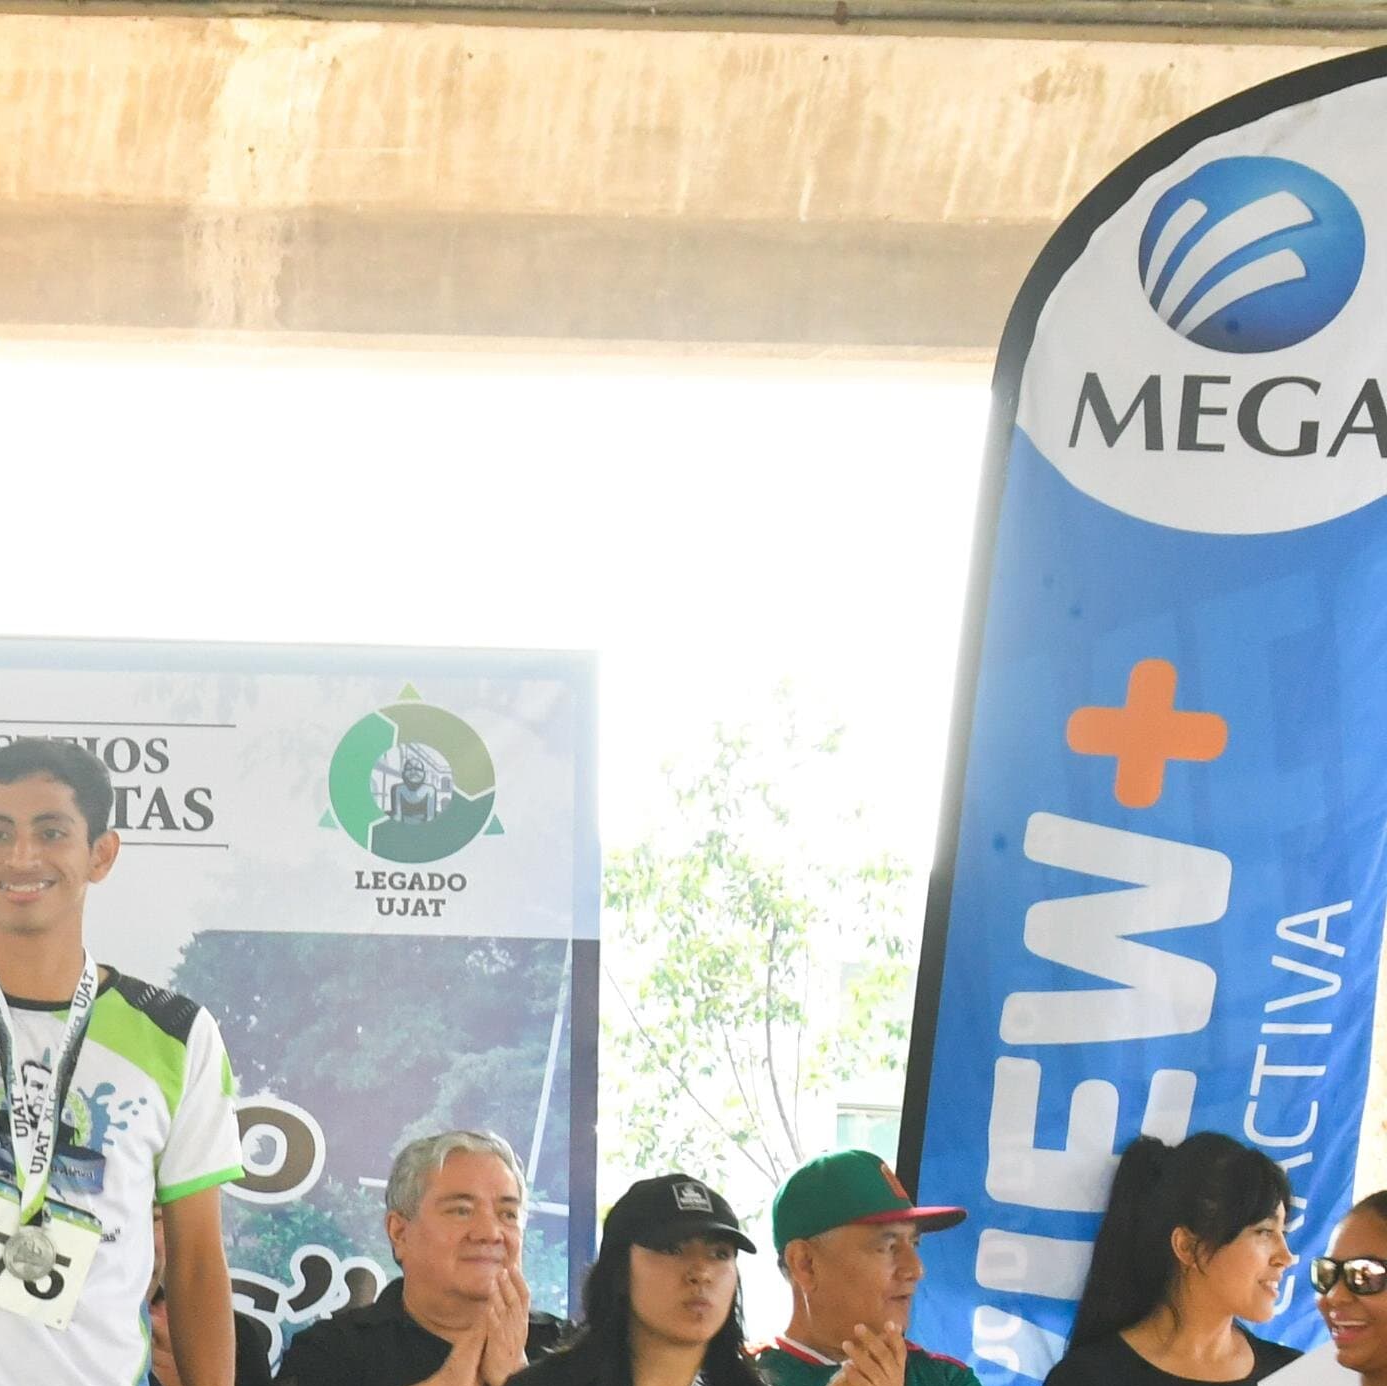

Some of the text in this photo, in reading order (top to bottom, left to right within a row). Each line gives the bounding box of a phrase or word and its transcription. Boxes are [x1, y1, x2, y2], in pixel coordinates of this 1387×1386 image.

[1069, 371, 1387, 458] MEGA
[354, 870, 467, 894] LEGADO
[376, 896, 447, 919] UJAT
[73, 970, 97, 1011] UJAT
[13, 1095, 29, 1140] UJAT
[29, 1131, 52, 1175] UJAT
